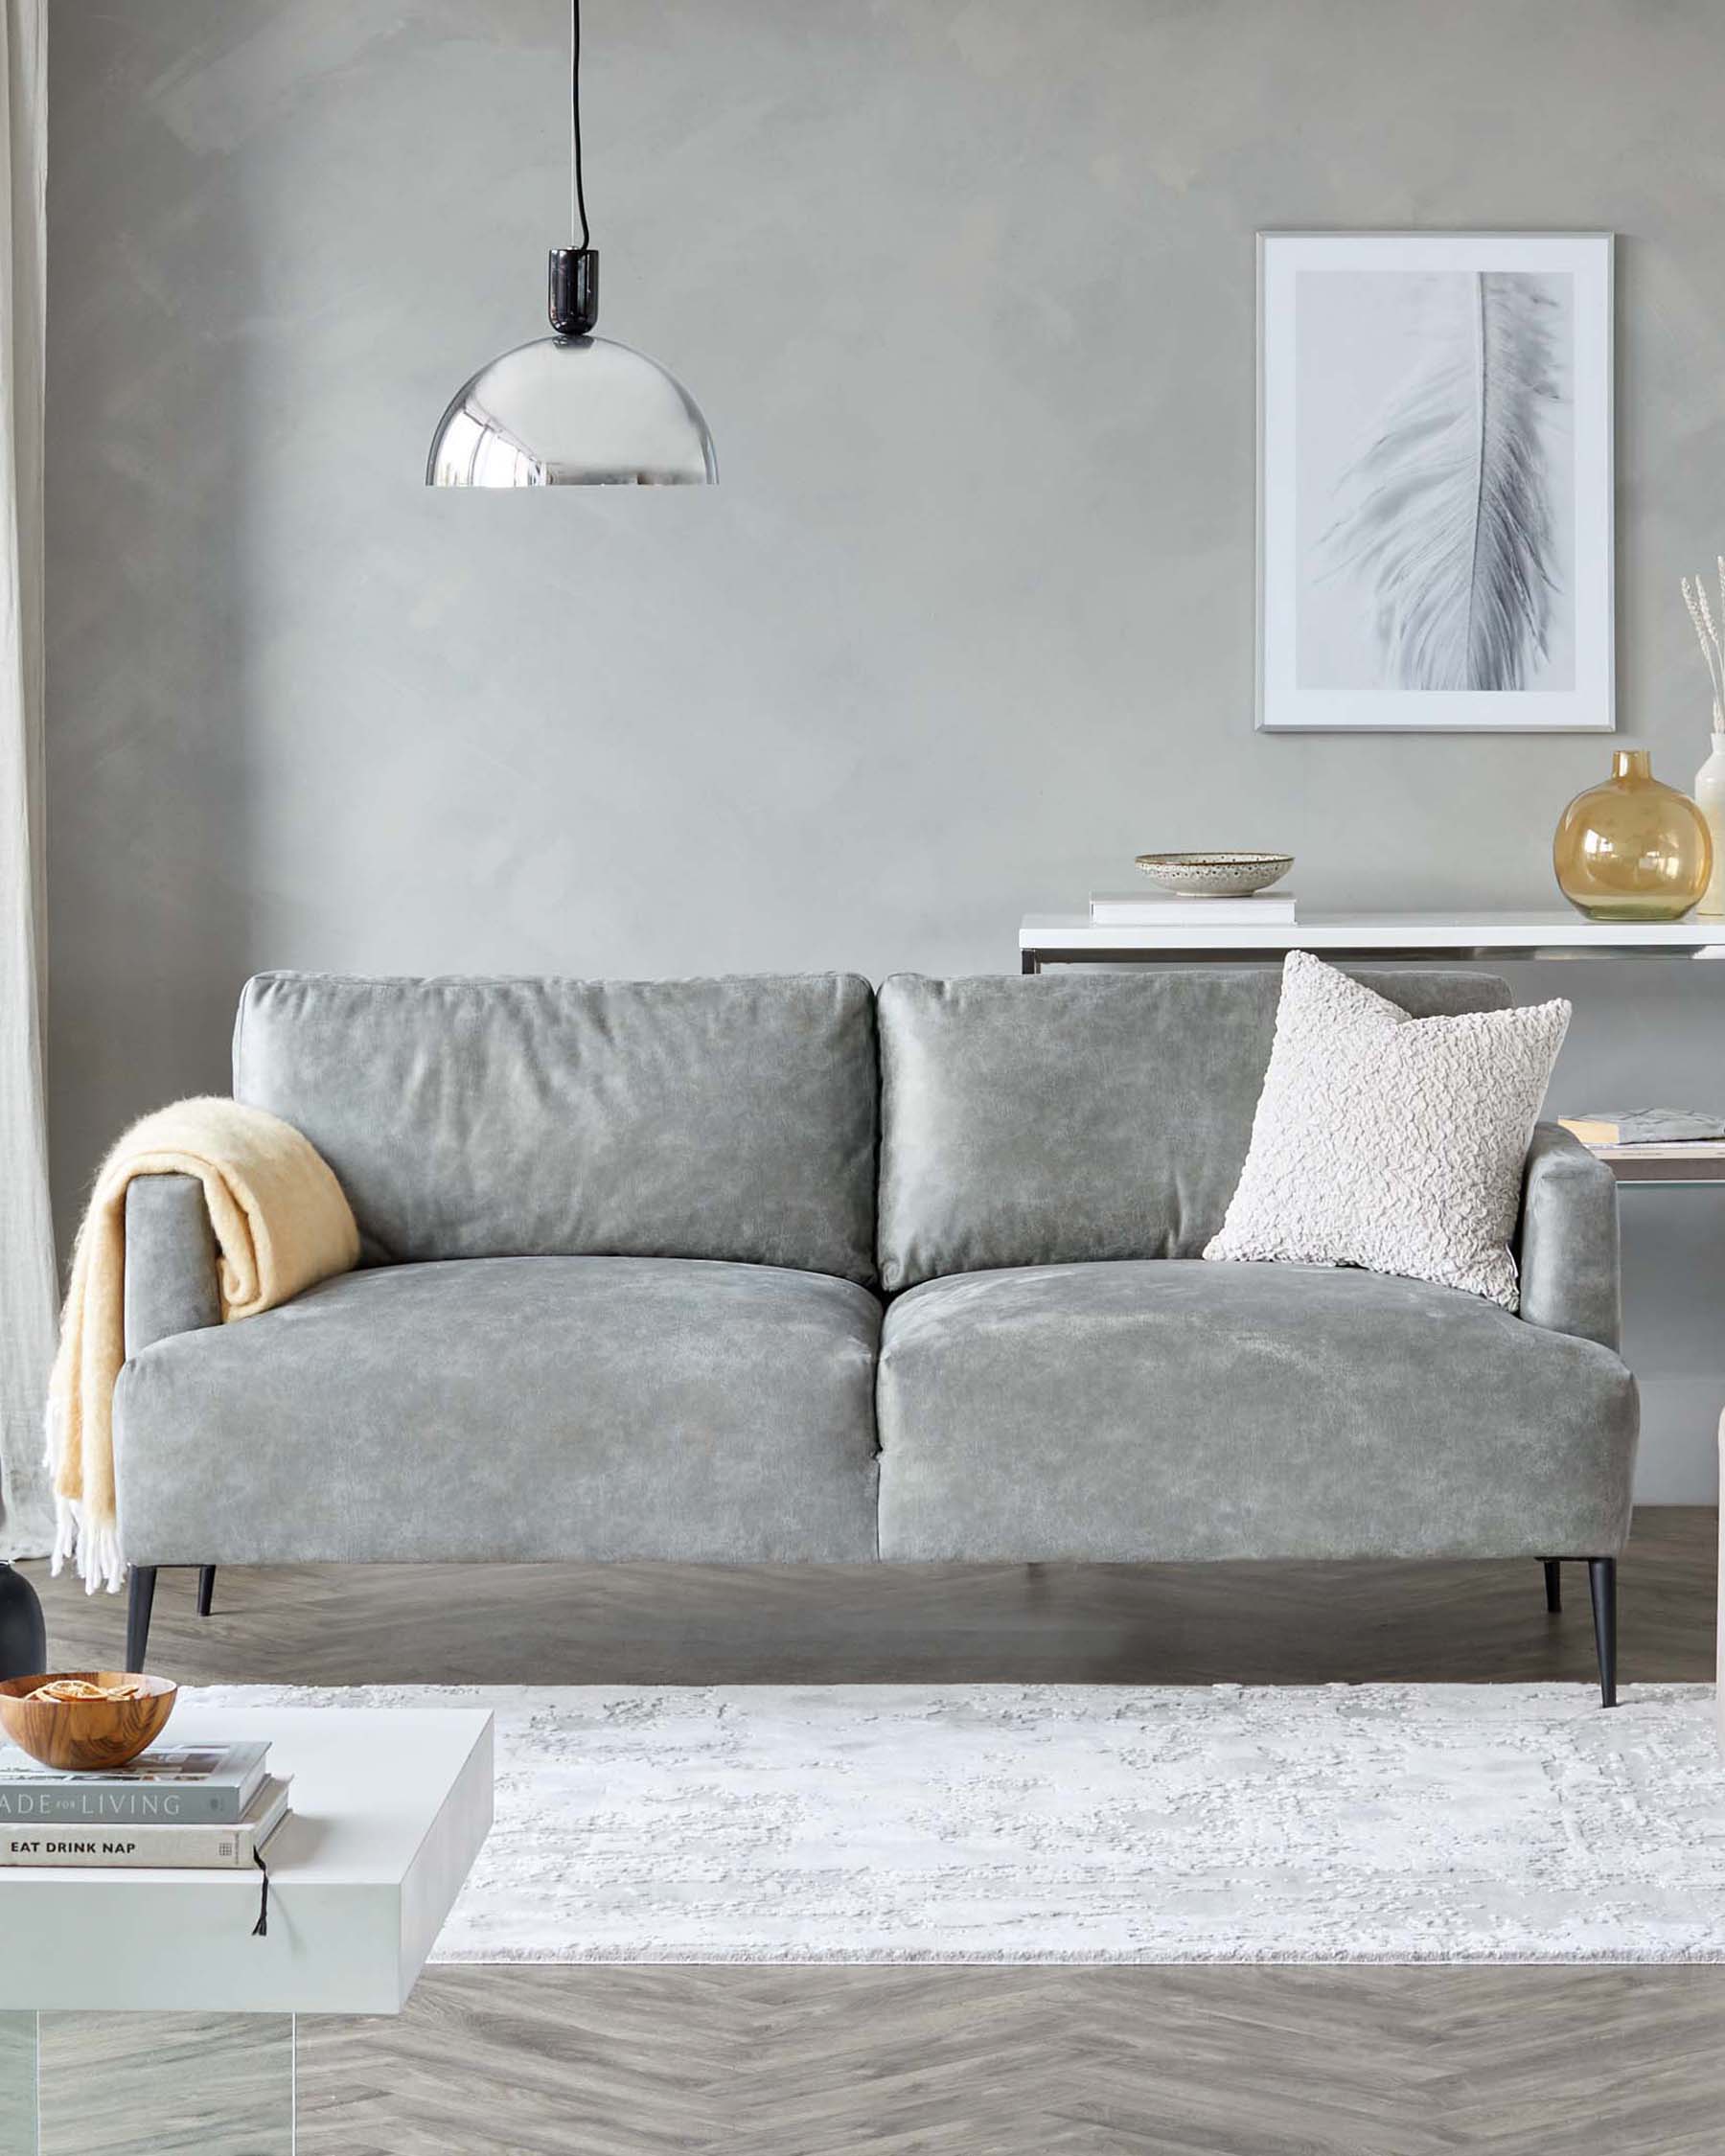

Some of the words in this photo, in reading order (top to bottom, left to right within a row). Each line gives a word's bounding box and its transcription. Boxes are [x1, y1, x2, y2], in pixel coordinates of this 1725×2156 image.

[81, 1794, 182, 1816] LIVING
[11, 1842, 40, 1853] EAT
[46, 1842, 96, 1854] DRINK
[103, 1843, 136, 1854] NAP
